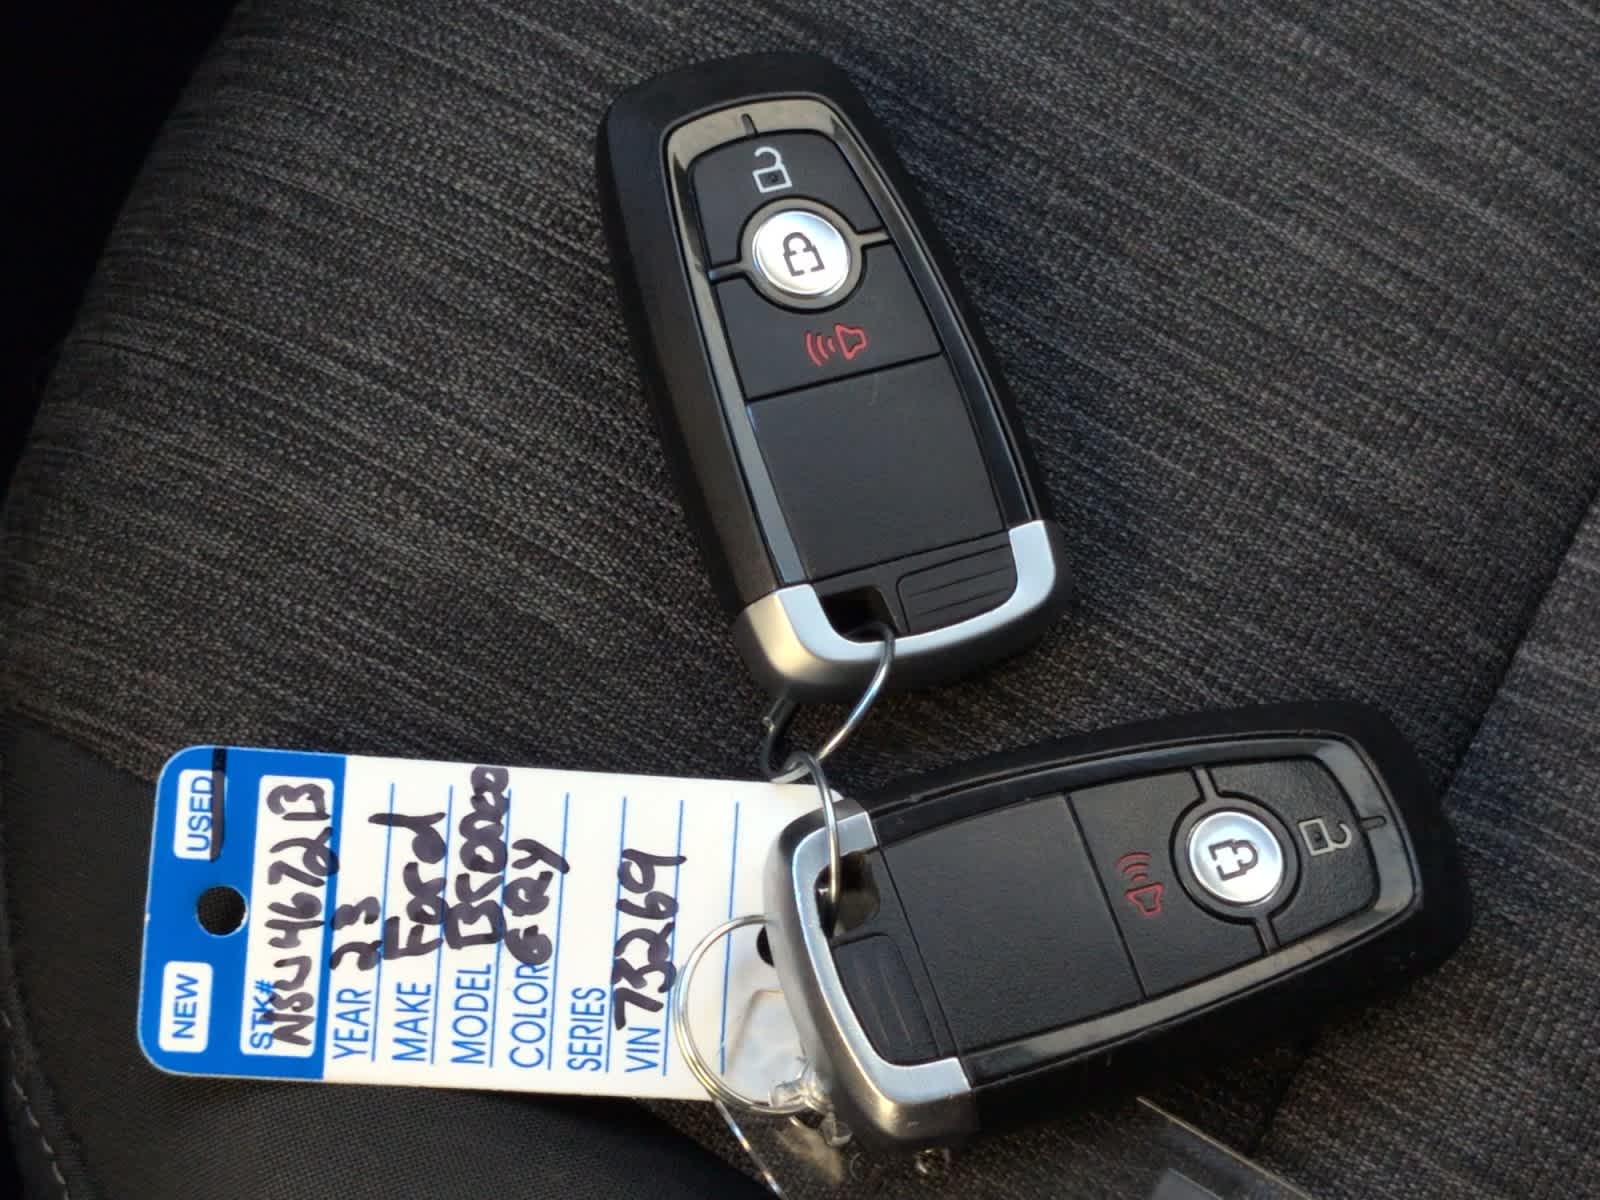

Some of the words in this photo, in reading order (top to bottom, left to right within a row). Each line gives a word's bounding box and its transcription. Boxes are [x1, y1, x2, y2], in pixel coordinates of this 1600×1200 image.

[186, 775, 215, 852] USED
[368, 812, 447, 960] Ford
[445, 766, 509, 950] Bronco
[330, 896, 382, 971] 23
[611, 848, 686, 1030] 73269
[172, 973, 199, 1039] NEW
[250, 978, 276, 1050] STK#
[332, 988, 372, 1059] YEAR
[392, 982, 432, 1061] MAKE
[451, 964, 491, 1064] MODEL
[509, 963, 550, 1068] COLOR
[568, 988, 606, 1071] SERIES
[625, 1027, 661, 1073] VIN
